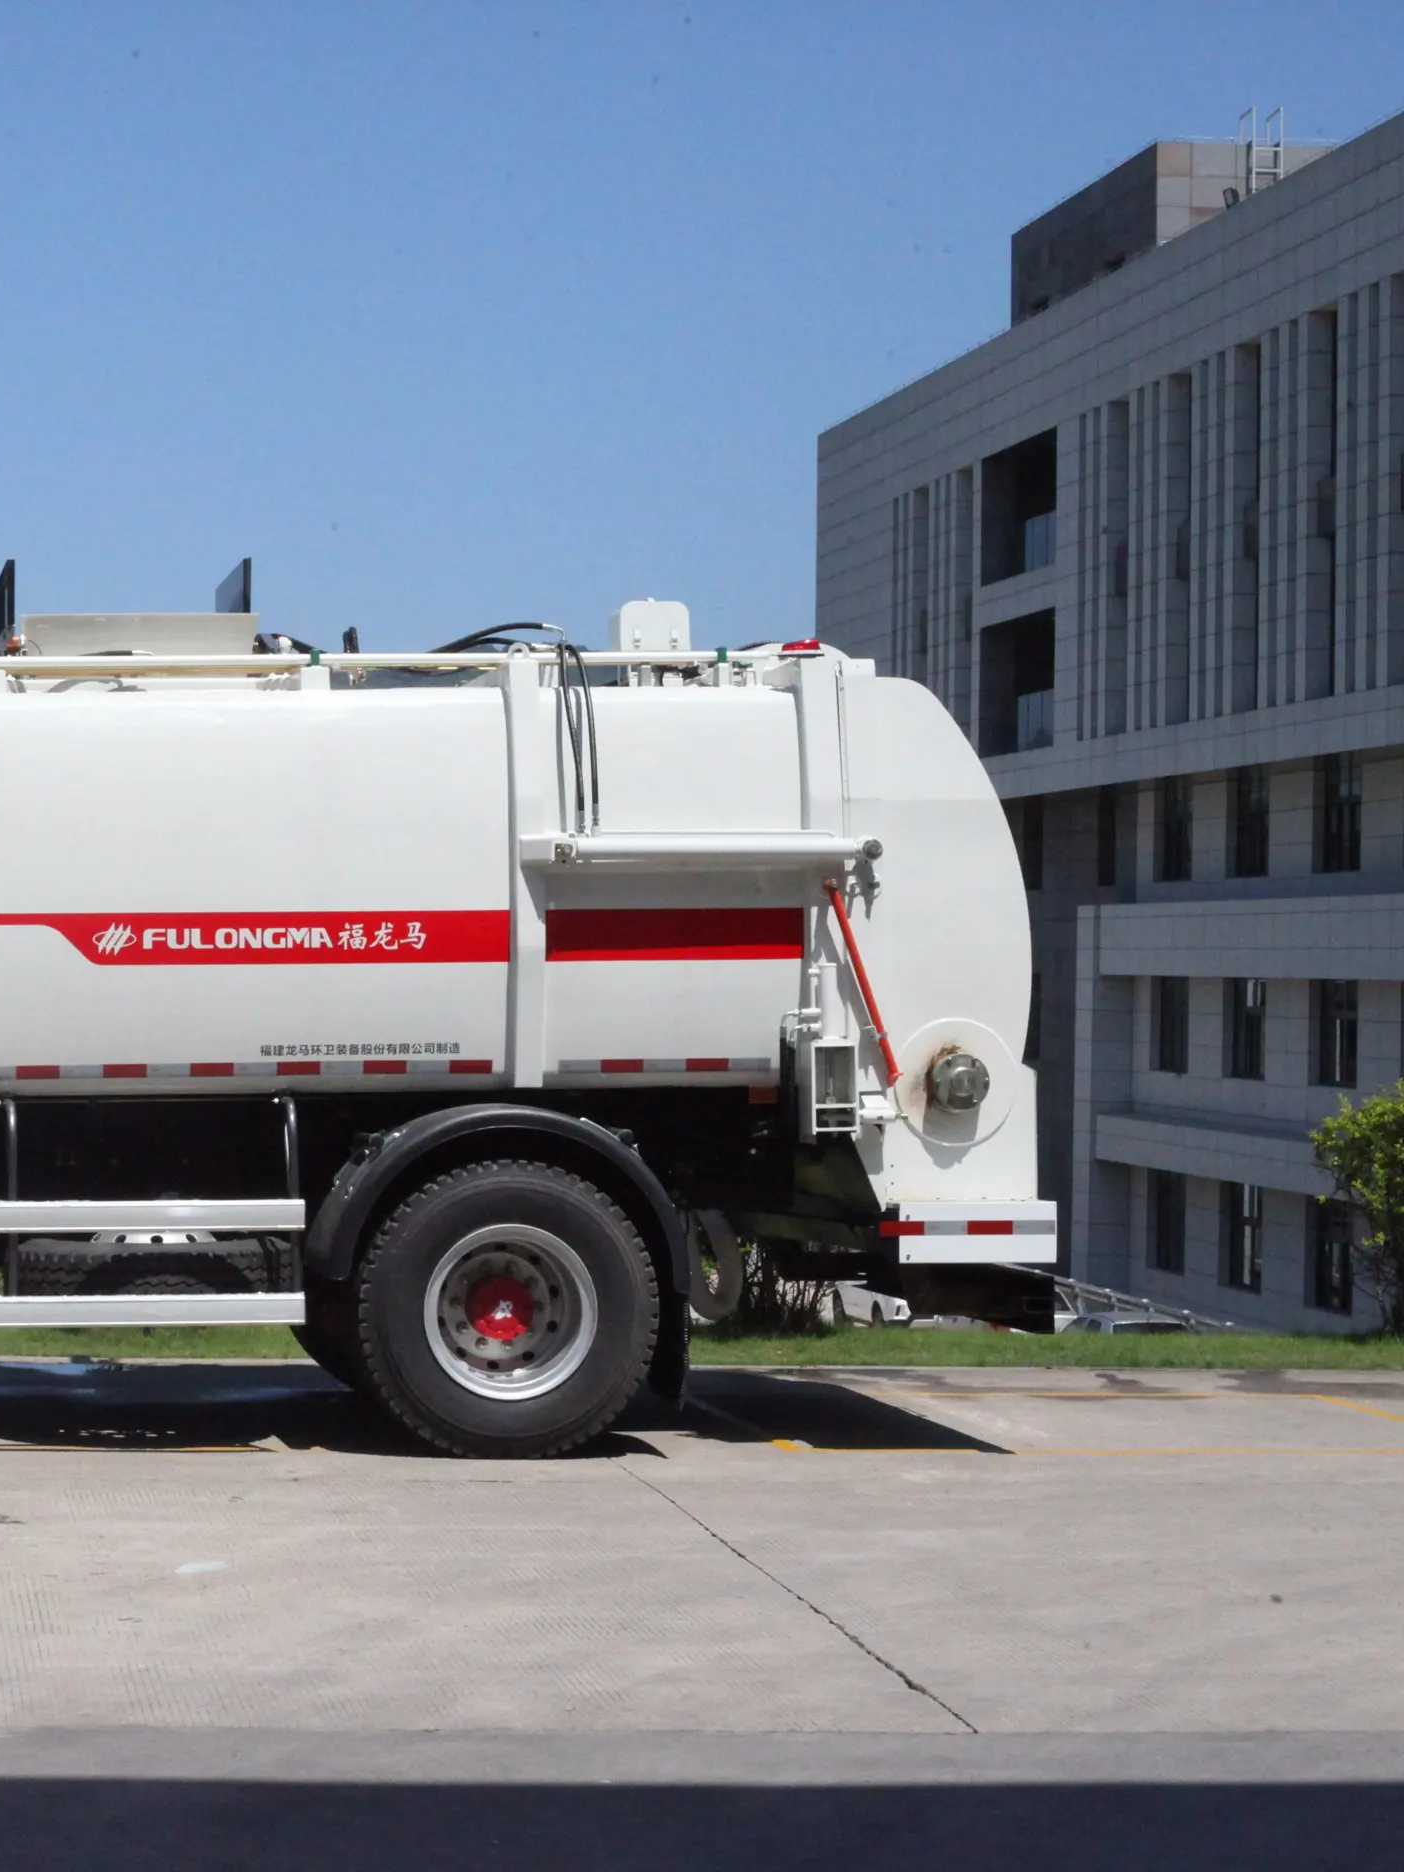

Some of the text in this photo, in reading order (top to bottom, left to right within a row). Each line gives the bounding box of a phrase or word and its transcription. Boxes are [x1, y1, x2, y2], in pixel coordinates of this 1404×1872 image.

[143, 921, 428, 951] FULONGMA 福龙马
[260, 1042, 461, 1058] 福建龙马环卫装备股份有限公司制造
